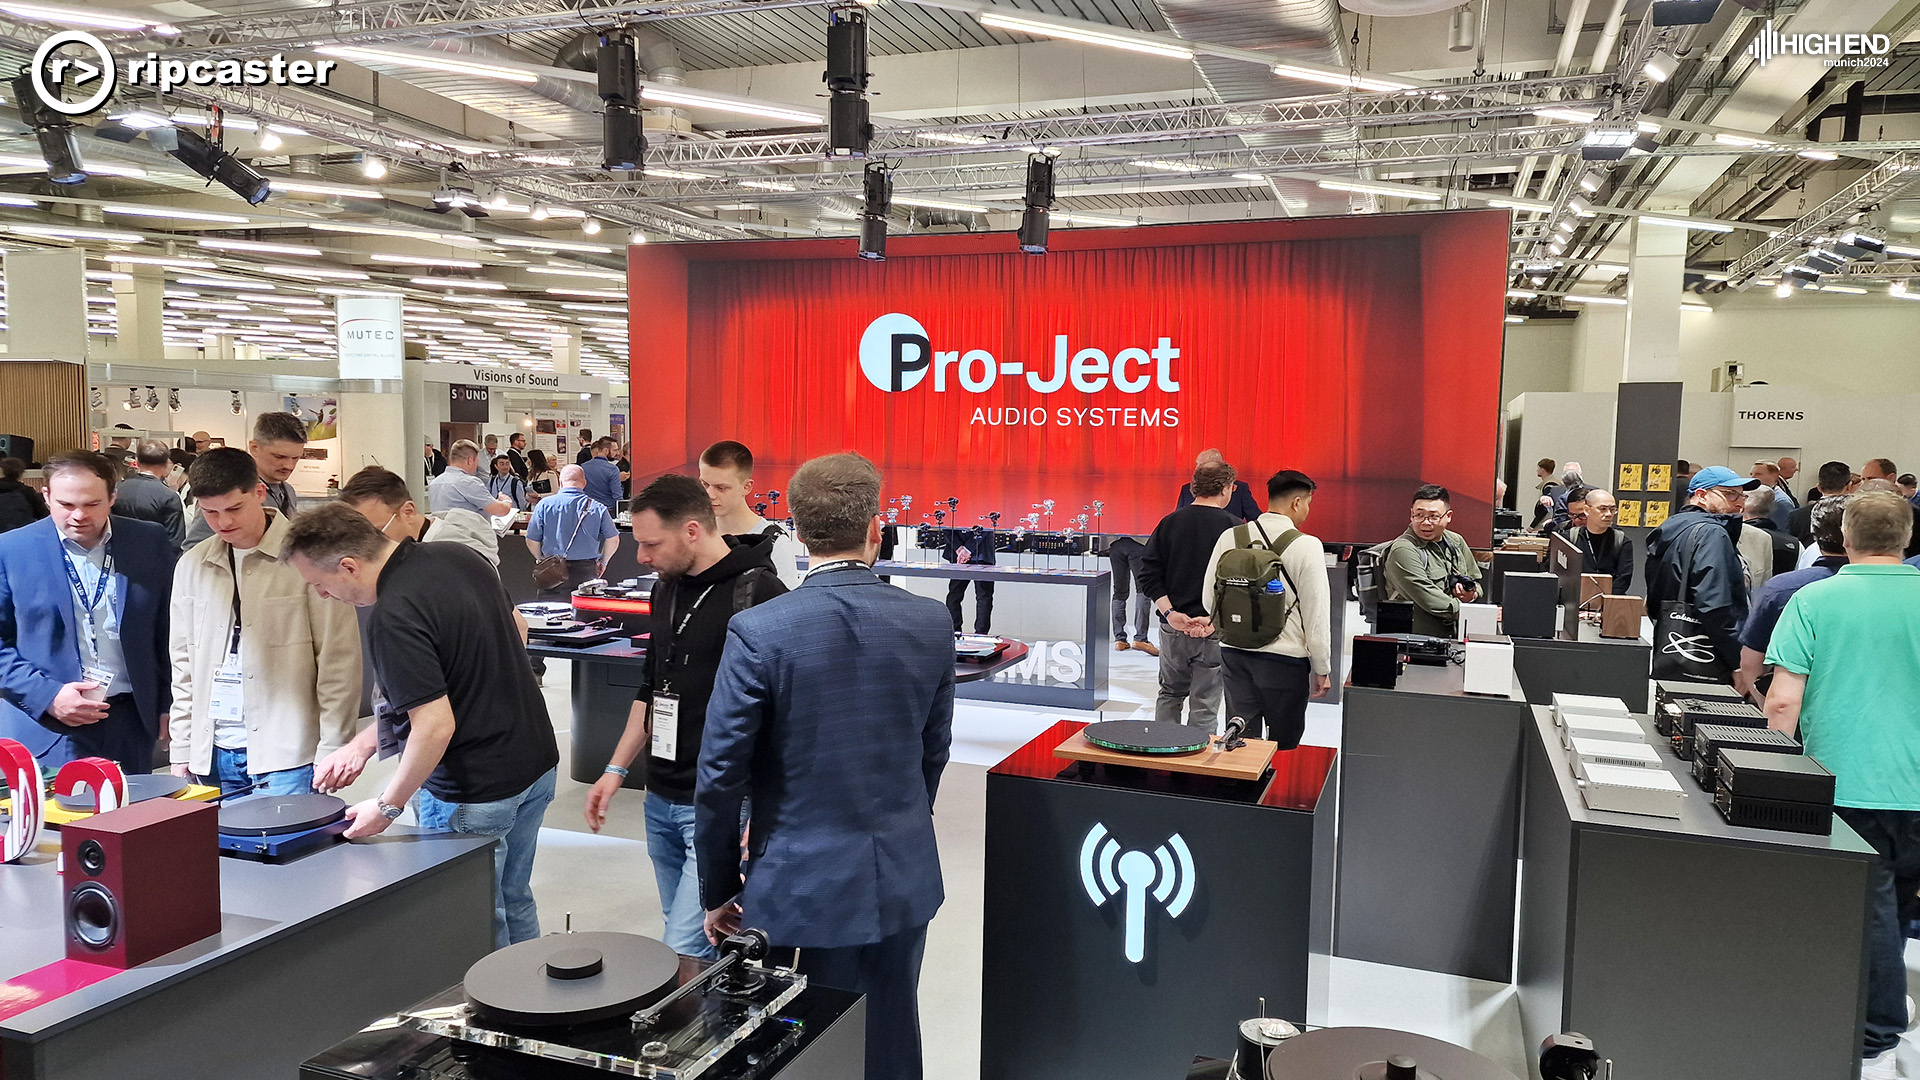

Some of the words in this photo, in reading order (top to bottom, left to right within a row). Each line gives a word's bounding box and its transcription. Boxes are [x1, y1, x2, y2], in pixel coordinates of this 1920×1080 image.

[346, 330, 395, 340] MUTEC
[890, 332, 1181, 394] Pro-Ject
[473, 369, 513, 384] Visions
[515, 373, 526, 384] of
[528, 374, 559, 387] Sound
[451, 387, 488, 402] SOUND
[970, 407, 1048, 426] AUDIO
[1056, 407, 1180, 428] SYSTEMS
[1738, 411, 1804, 421] THORENS
[994, 640, 1083, 683] MS
